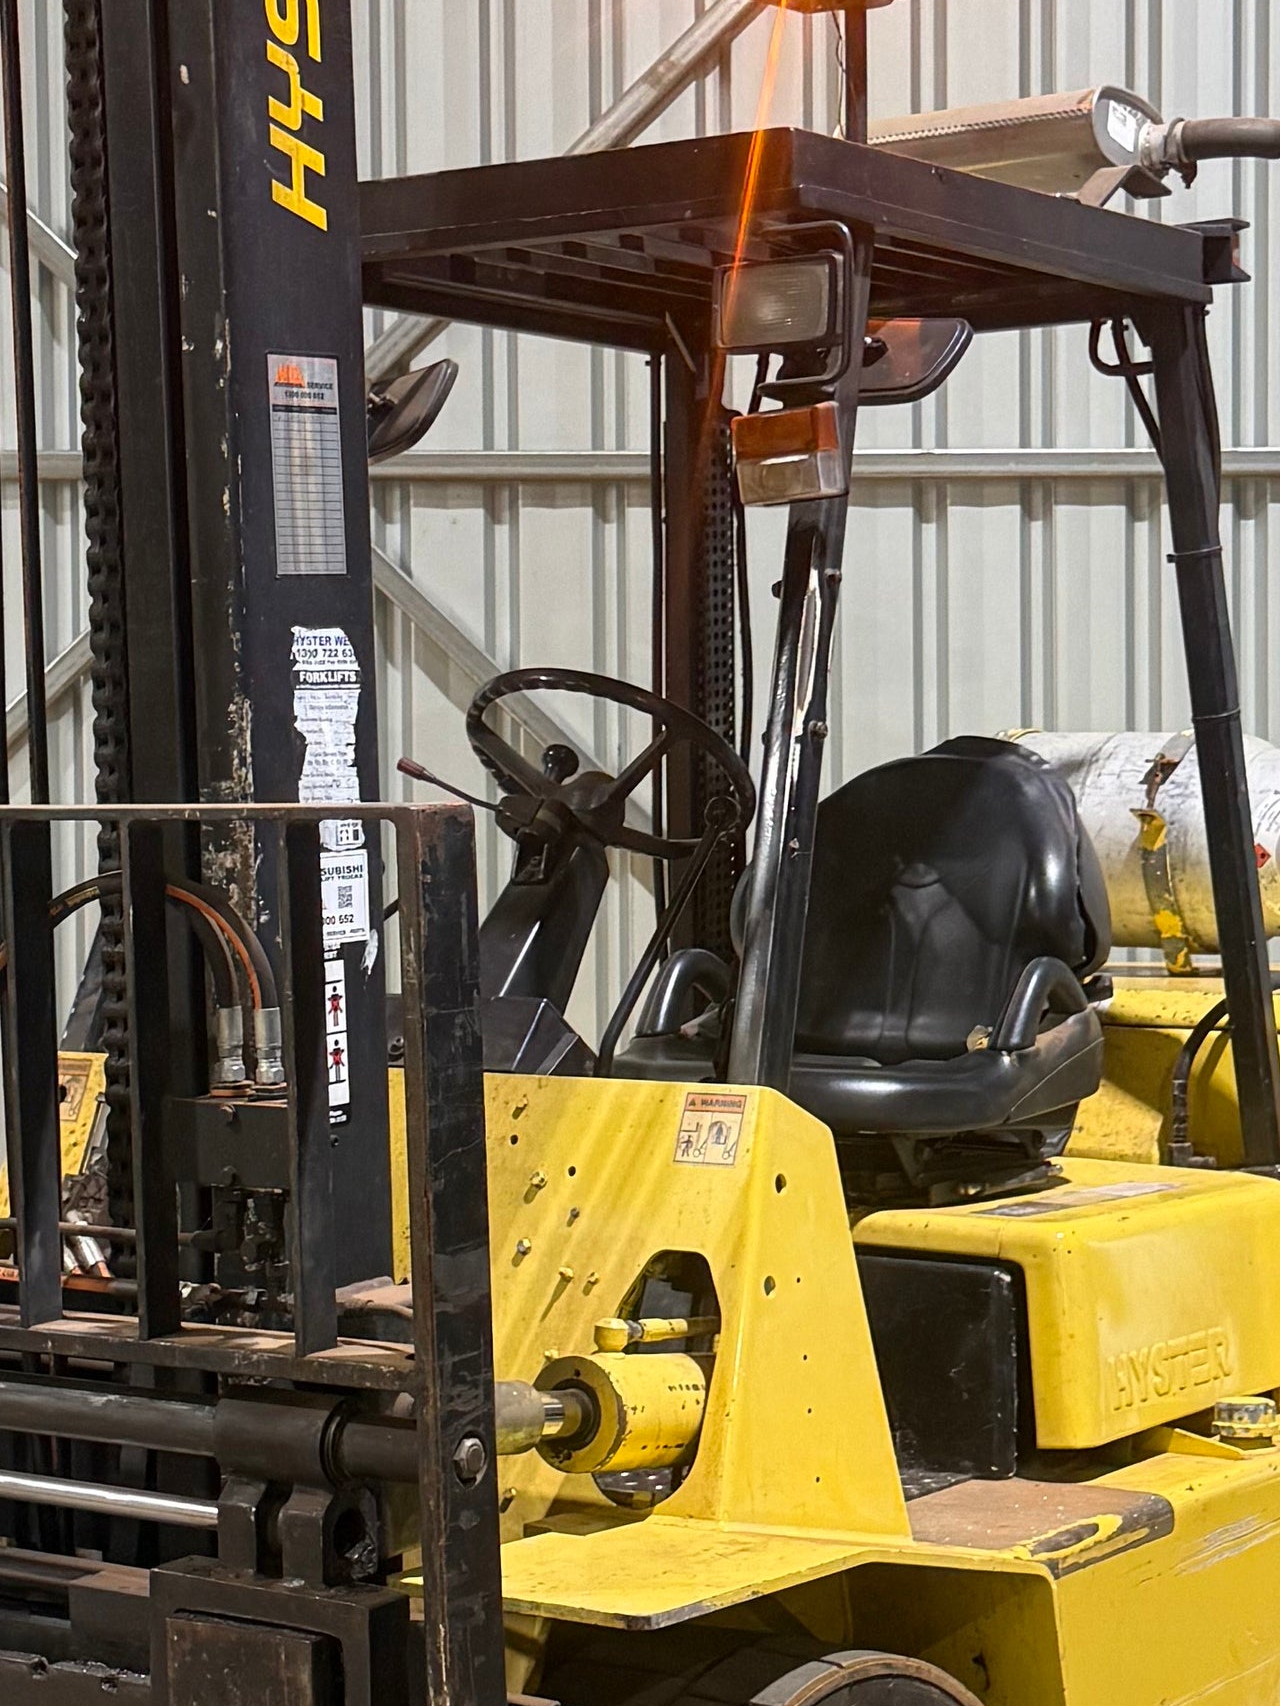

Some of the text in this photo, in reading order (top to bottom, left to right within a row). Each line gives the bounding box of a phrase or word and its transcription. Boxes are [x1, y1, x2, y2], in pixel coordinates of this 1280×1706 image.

[322, 648, 339, 658] 722
[299, 671, 357, 684] FORKLIFTS
[701, 1097, 742, 1109] WARNING
[1108, 1326, 1233, 1412] HYSTER
